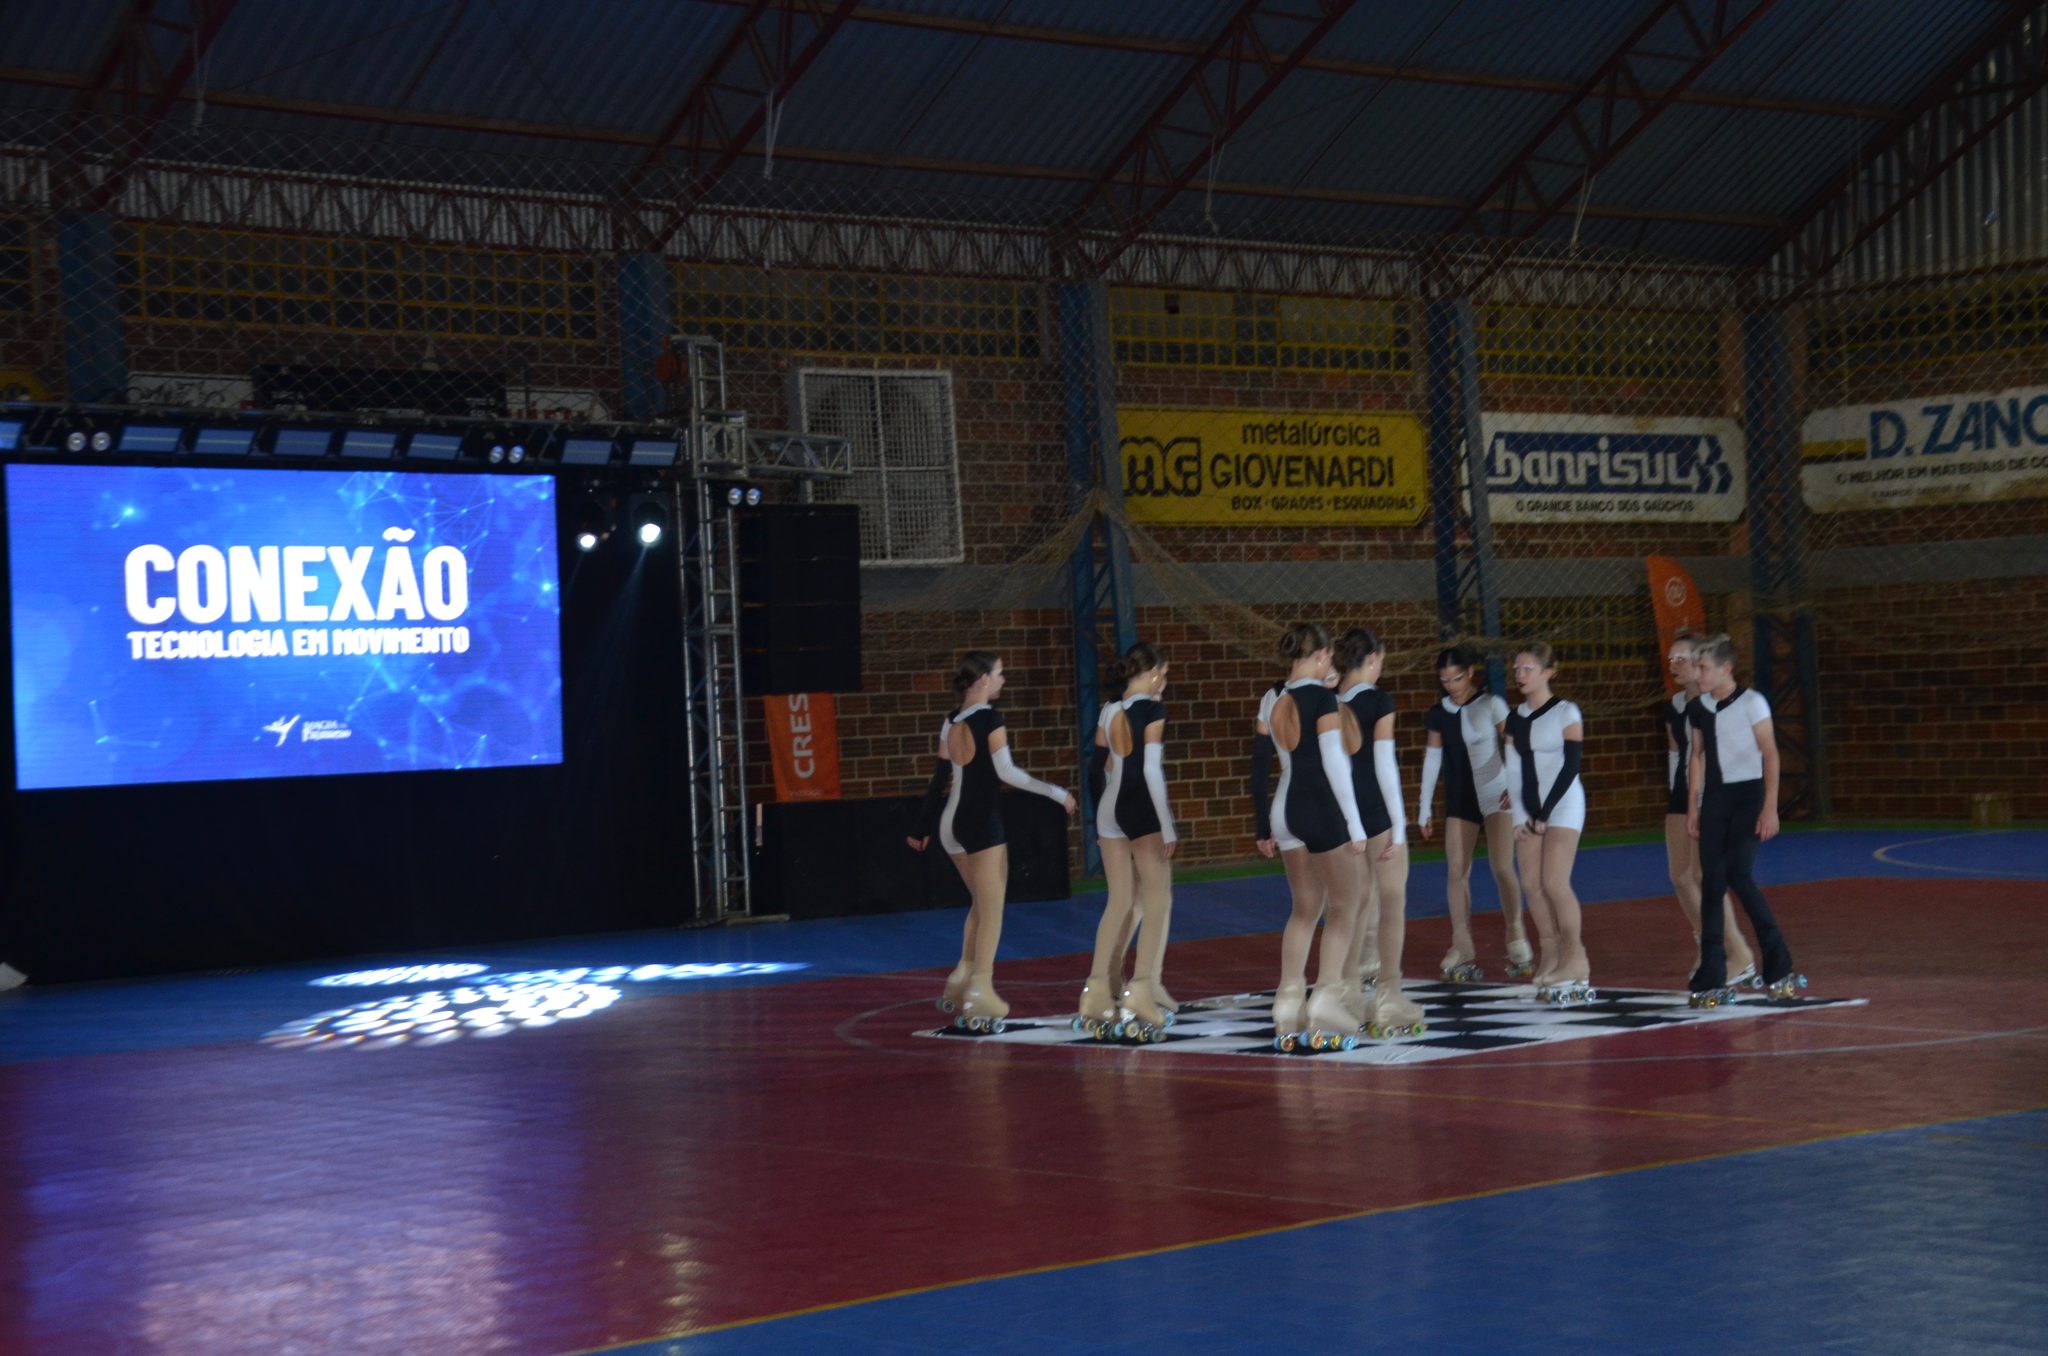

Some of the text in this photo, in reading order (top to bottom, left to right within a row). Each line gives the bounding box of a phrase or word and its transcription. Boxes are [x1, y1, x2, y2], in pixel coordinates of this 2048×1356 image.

[1210, 453, 1395, 489] GIOVENARDI
[1486, 436, 1698, 488] banrisul
[1851, 468, 1905, 483] MELHOR
[1907, 465, 1929, 479] EM
[1930, 459, 2005, 478] MATERIAIS
[2008, 456, 2028, 469] DE
[1231, 496, 1417, 512] BOX GRADES ESQUADRIAS
[1515, 500, 1525, 512] O
[1526, 500, 1571, 512] GRANDE
[1575, 500, 1615, 513] BANCO
[1618, 500, 1641, 513] DOS
[125, 526, 470, 624] CONEXÃO
[127, 626, 471, 660] TECNOLOGIA EM MOVIMENTO
